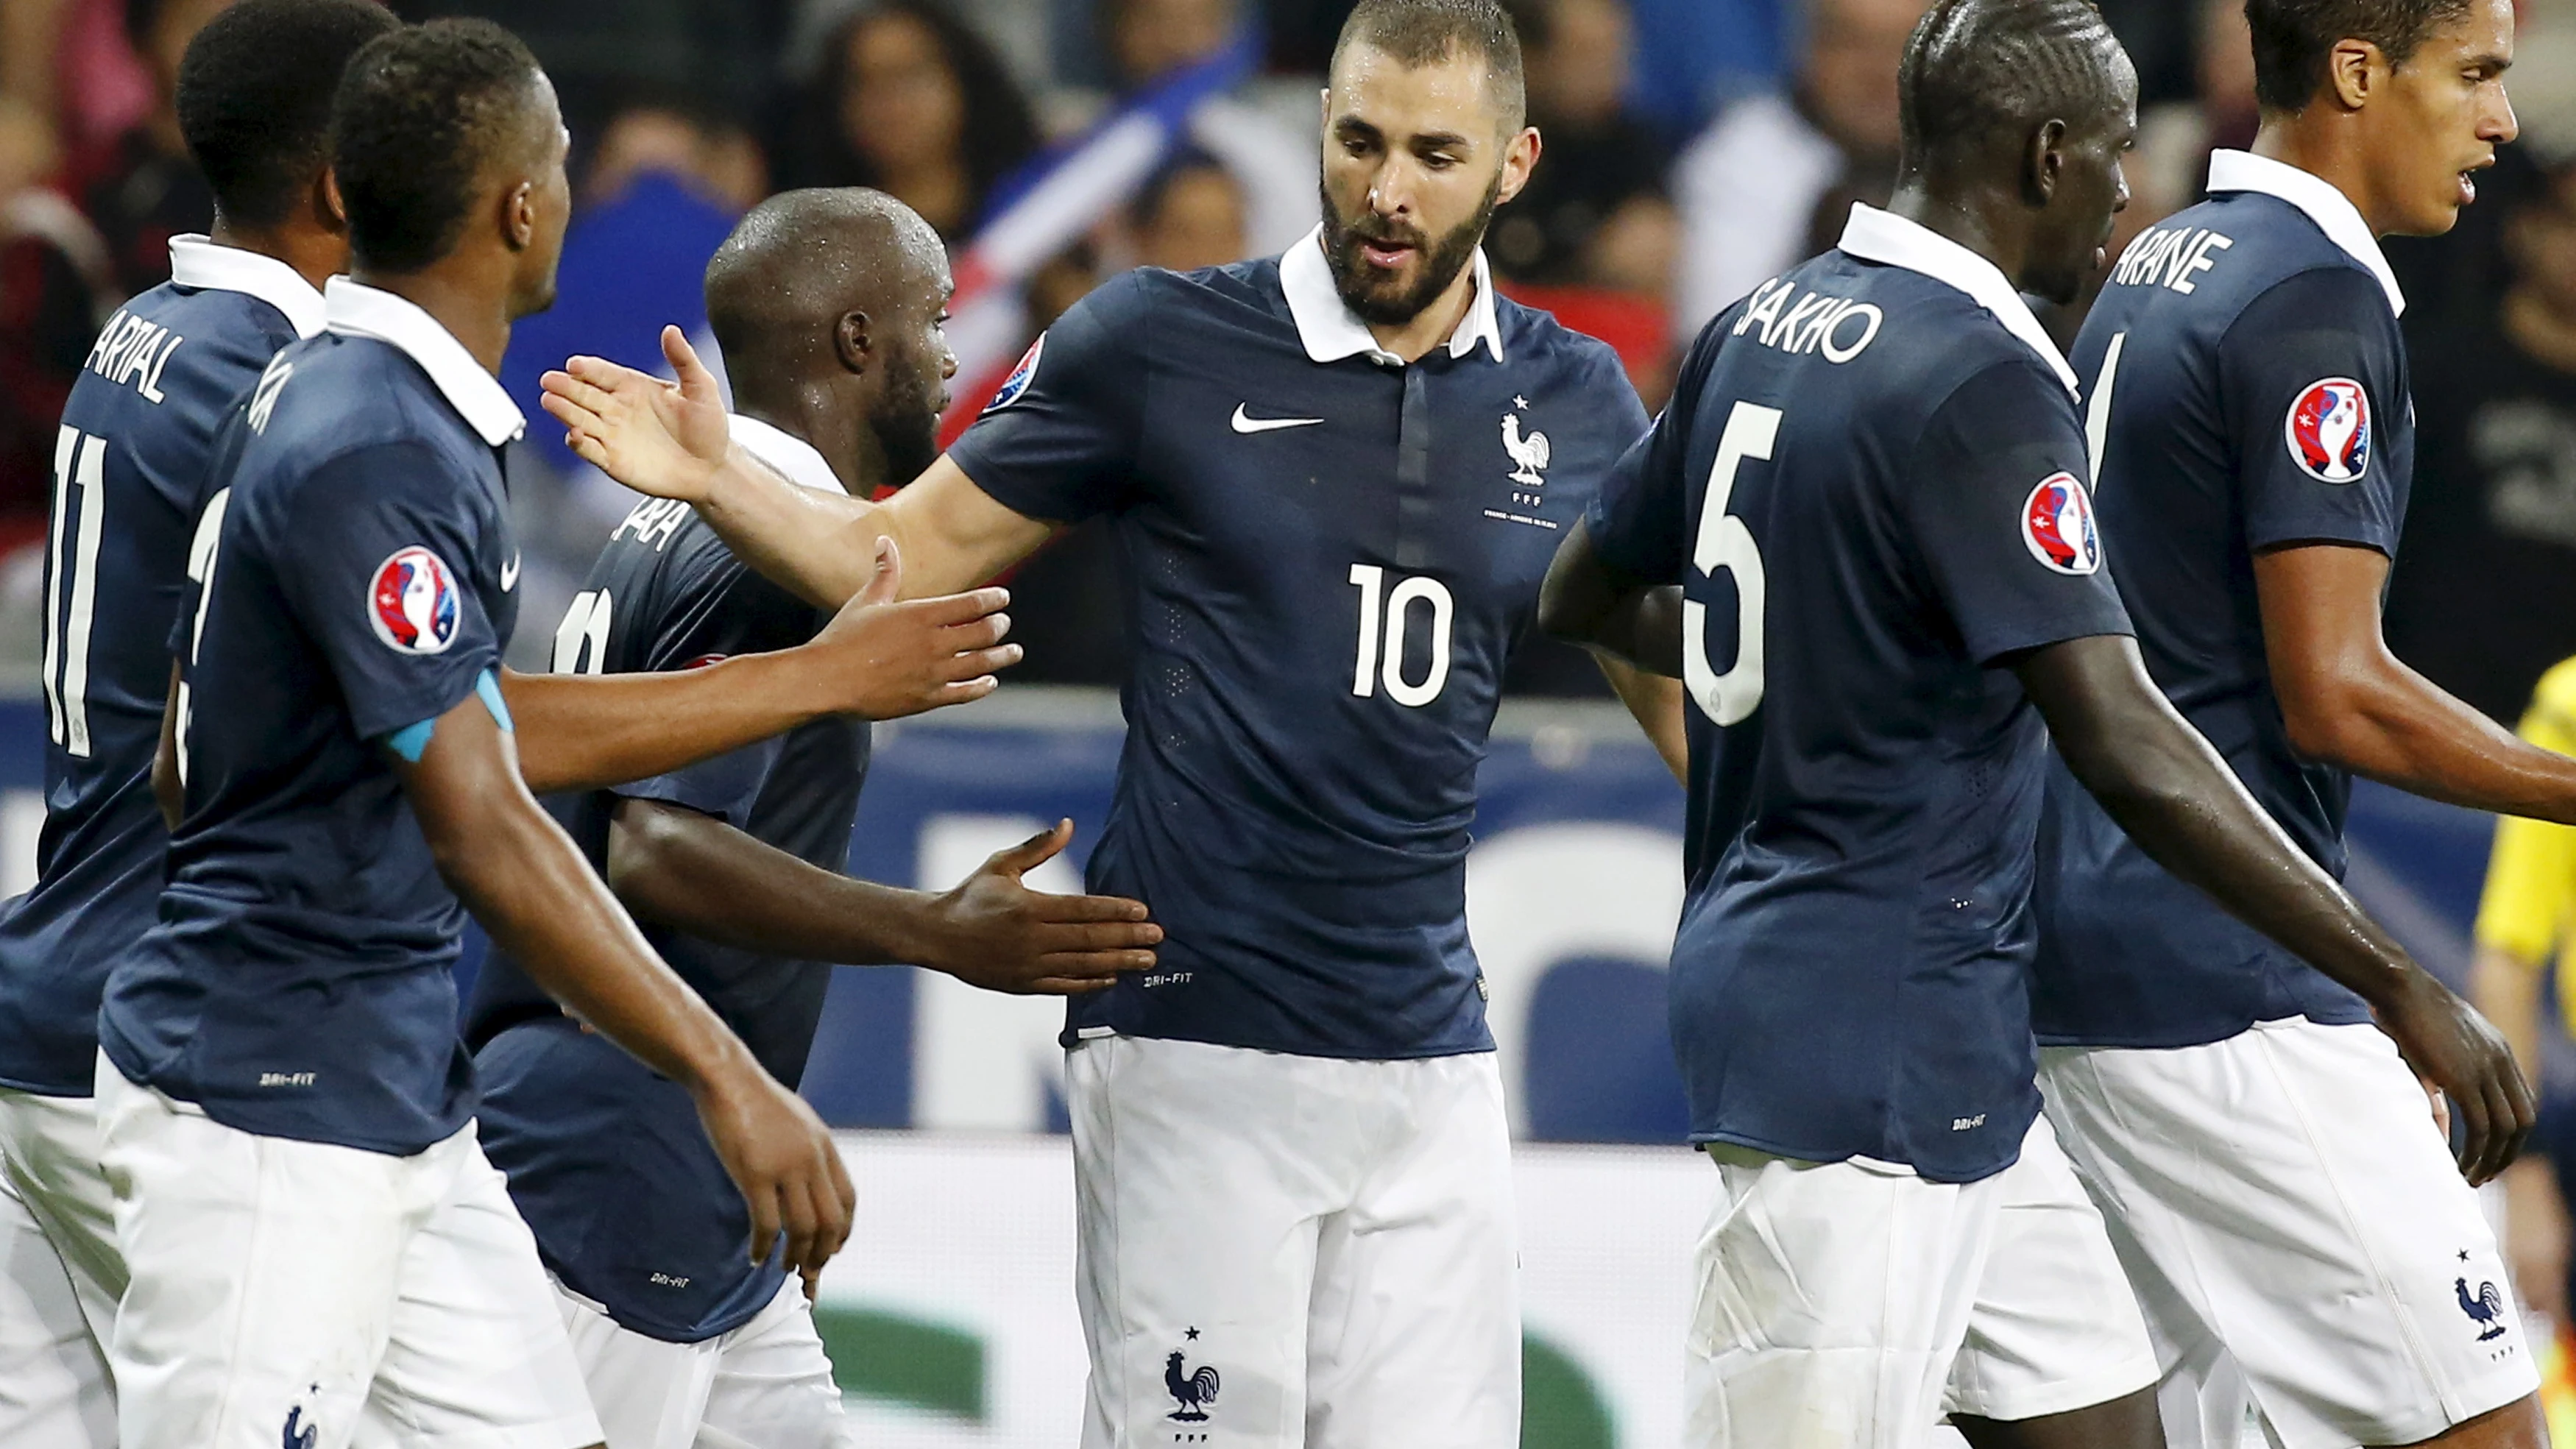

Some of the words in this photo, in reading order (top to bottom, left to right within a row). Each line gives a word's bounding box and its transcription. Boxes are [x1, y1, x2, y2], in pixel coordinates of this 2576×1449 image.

[2106, 226, 2234, 295] ARANE
[84, 309, 183, 404] ARTIAL
[1732, 277, 1883, 364] SAKHO
[44, 423, 107, 759] 11
[1682, 400, 1784, 727] 5
[1349, 564, 1453, 706] 10
[1144, 972, 1193, 988] DRI-FIT
[259, 1072, 316, 1086] DRI-FIT
